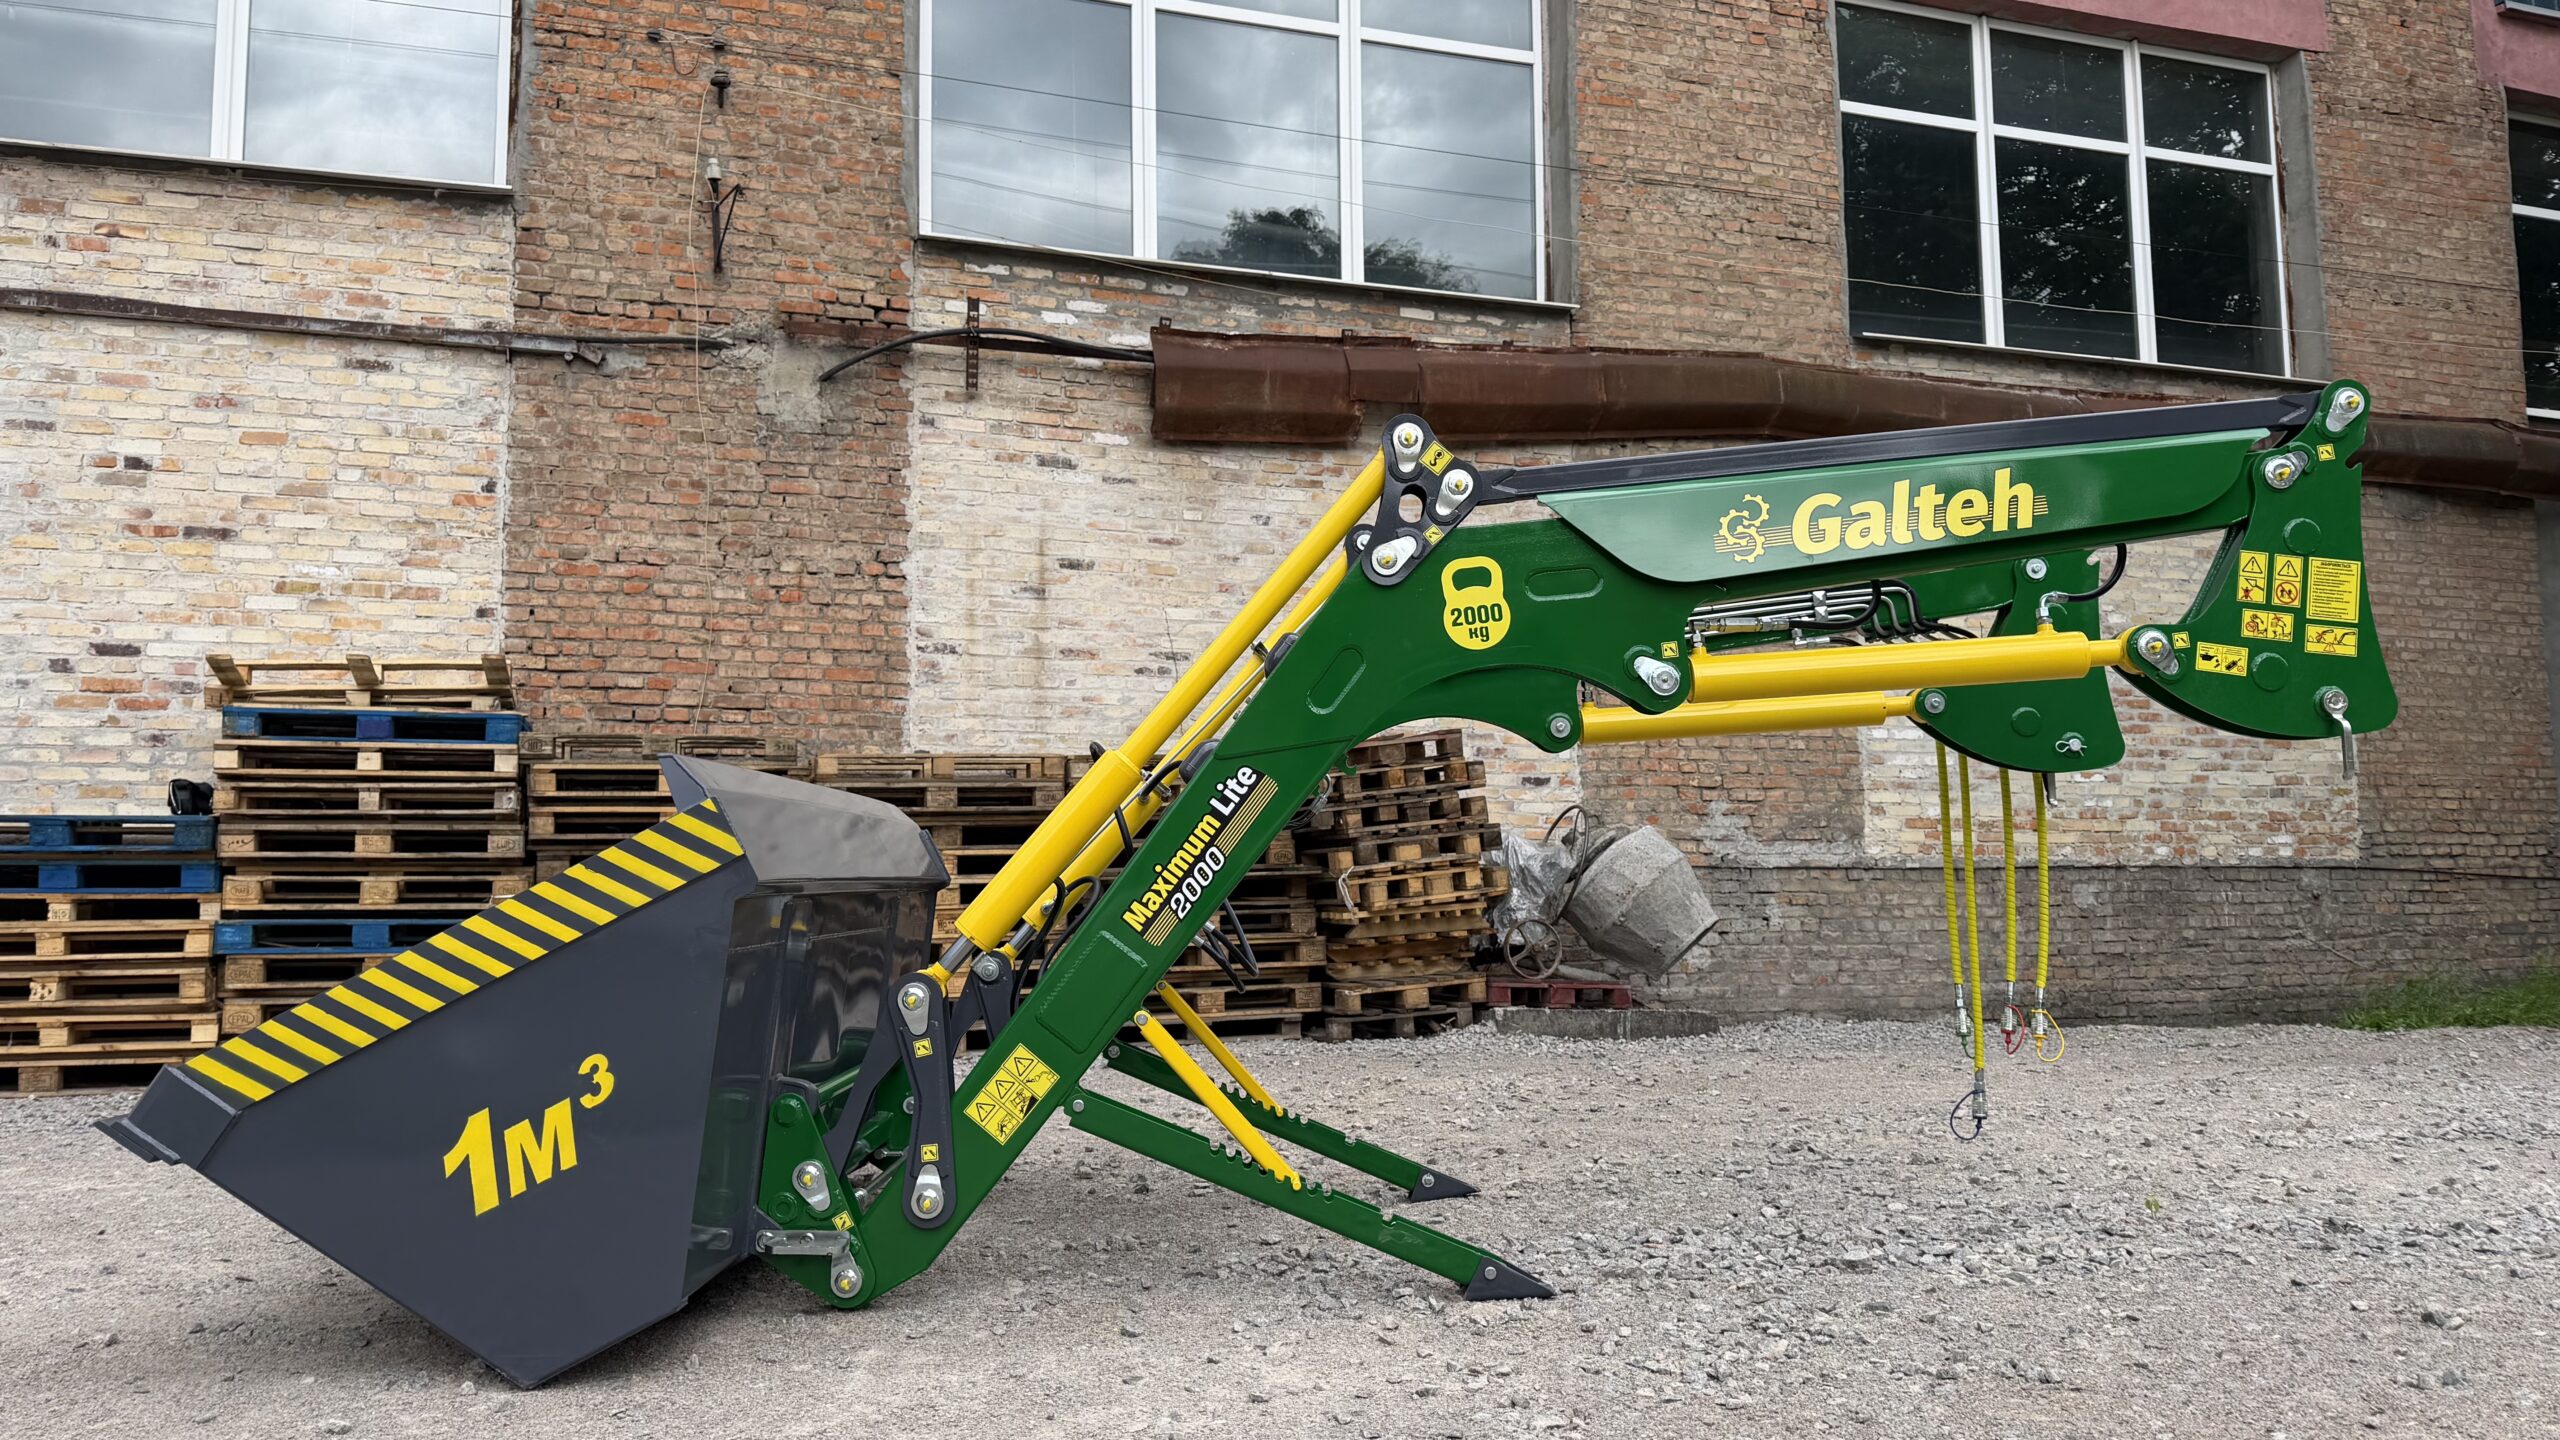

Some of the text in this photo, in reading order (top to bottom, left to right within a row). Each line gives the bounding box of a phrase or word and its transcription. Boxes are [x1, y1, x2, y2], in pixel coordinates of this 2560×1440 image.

[1792, 466, 2035, 556] Galteh
[1450, 602, 1504, 627] 2000
[1121, 765, 1258, 933] Maximum Lite
[1169, 845, 1226, 920] 2000
